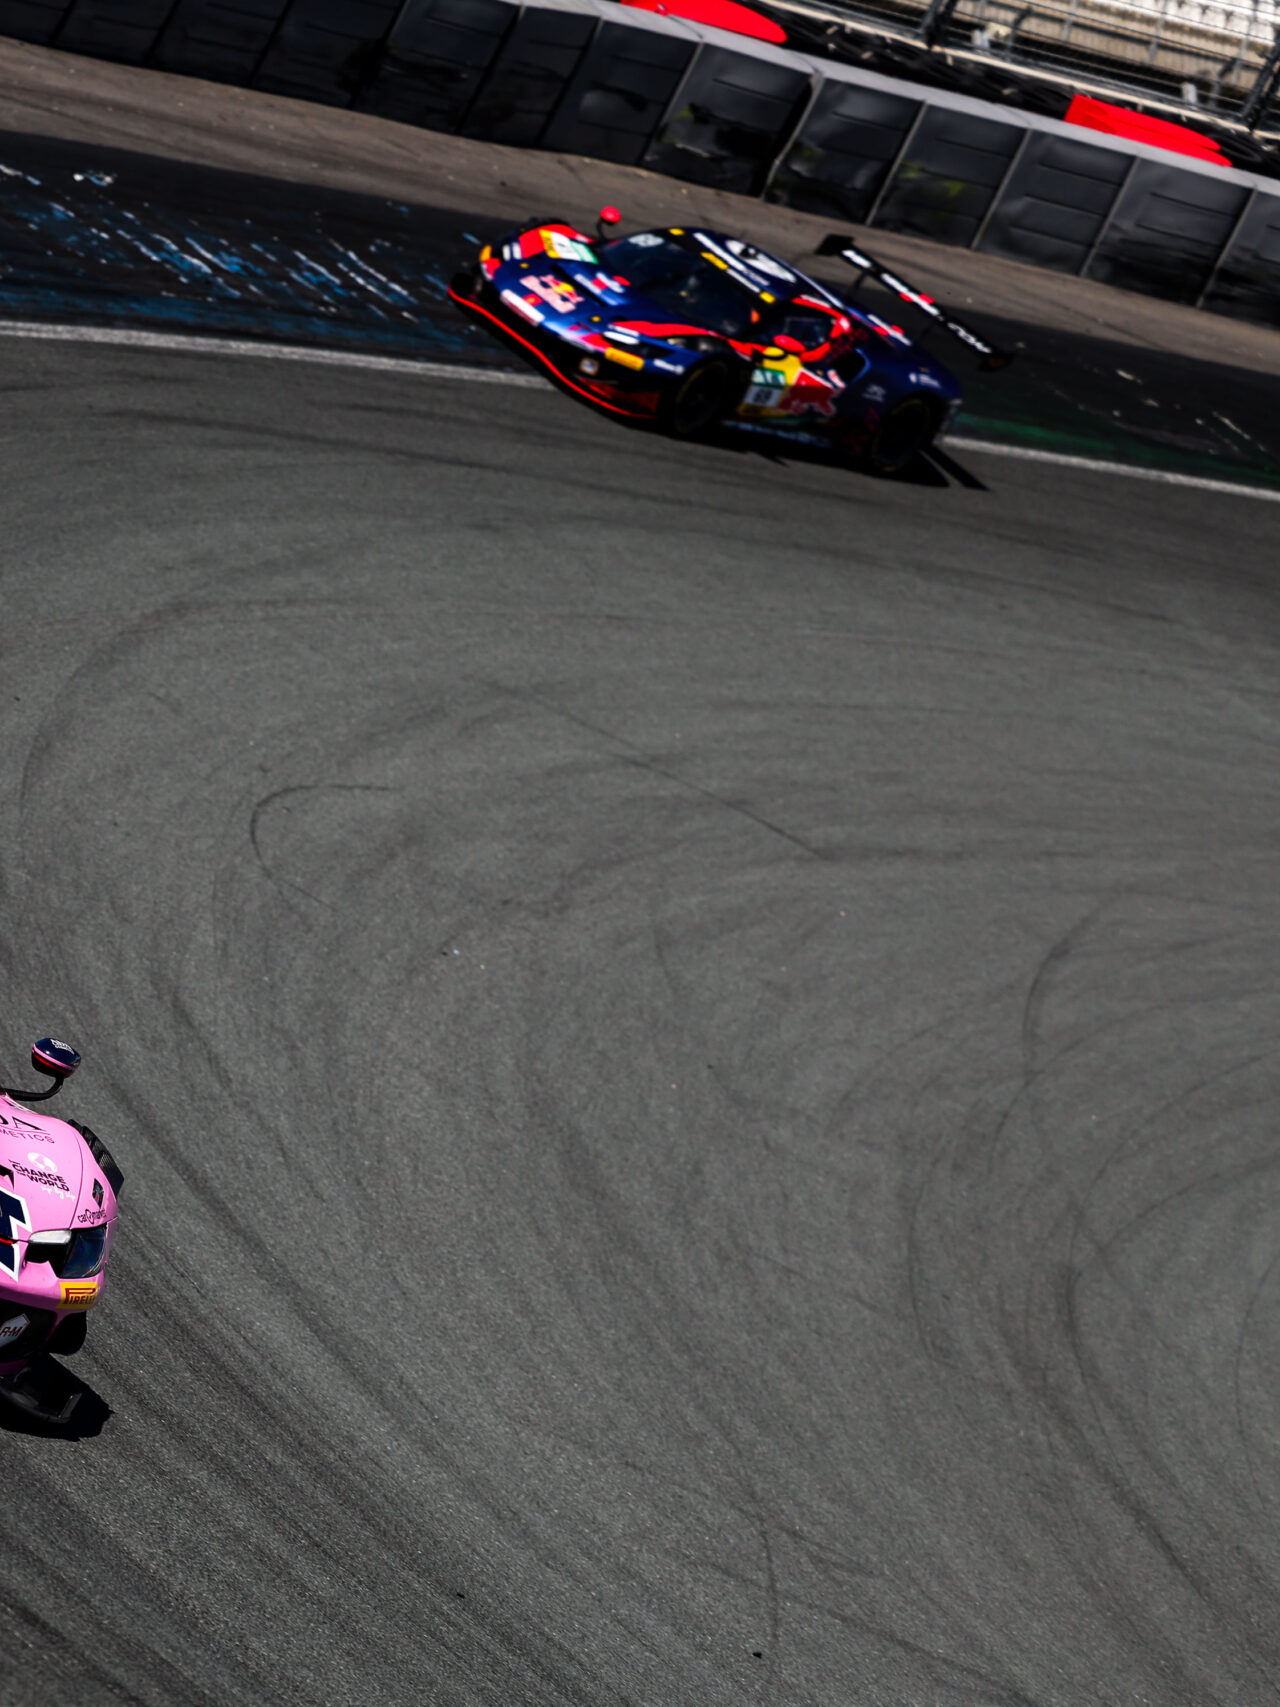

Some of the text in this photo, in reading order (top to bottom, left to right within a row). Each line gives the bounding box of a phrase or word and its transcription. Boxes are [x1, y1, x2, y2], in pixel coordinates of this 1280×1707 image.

[12, 1163, 66, 1185] CHANGE
[27, 1175, 70, 1192] WORLD
[62, 1287, 97, 1305] PIRELLI
